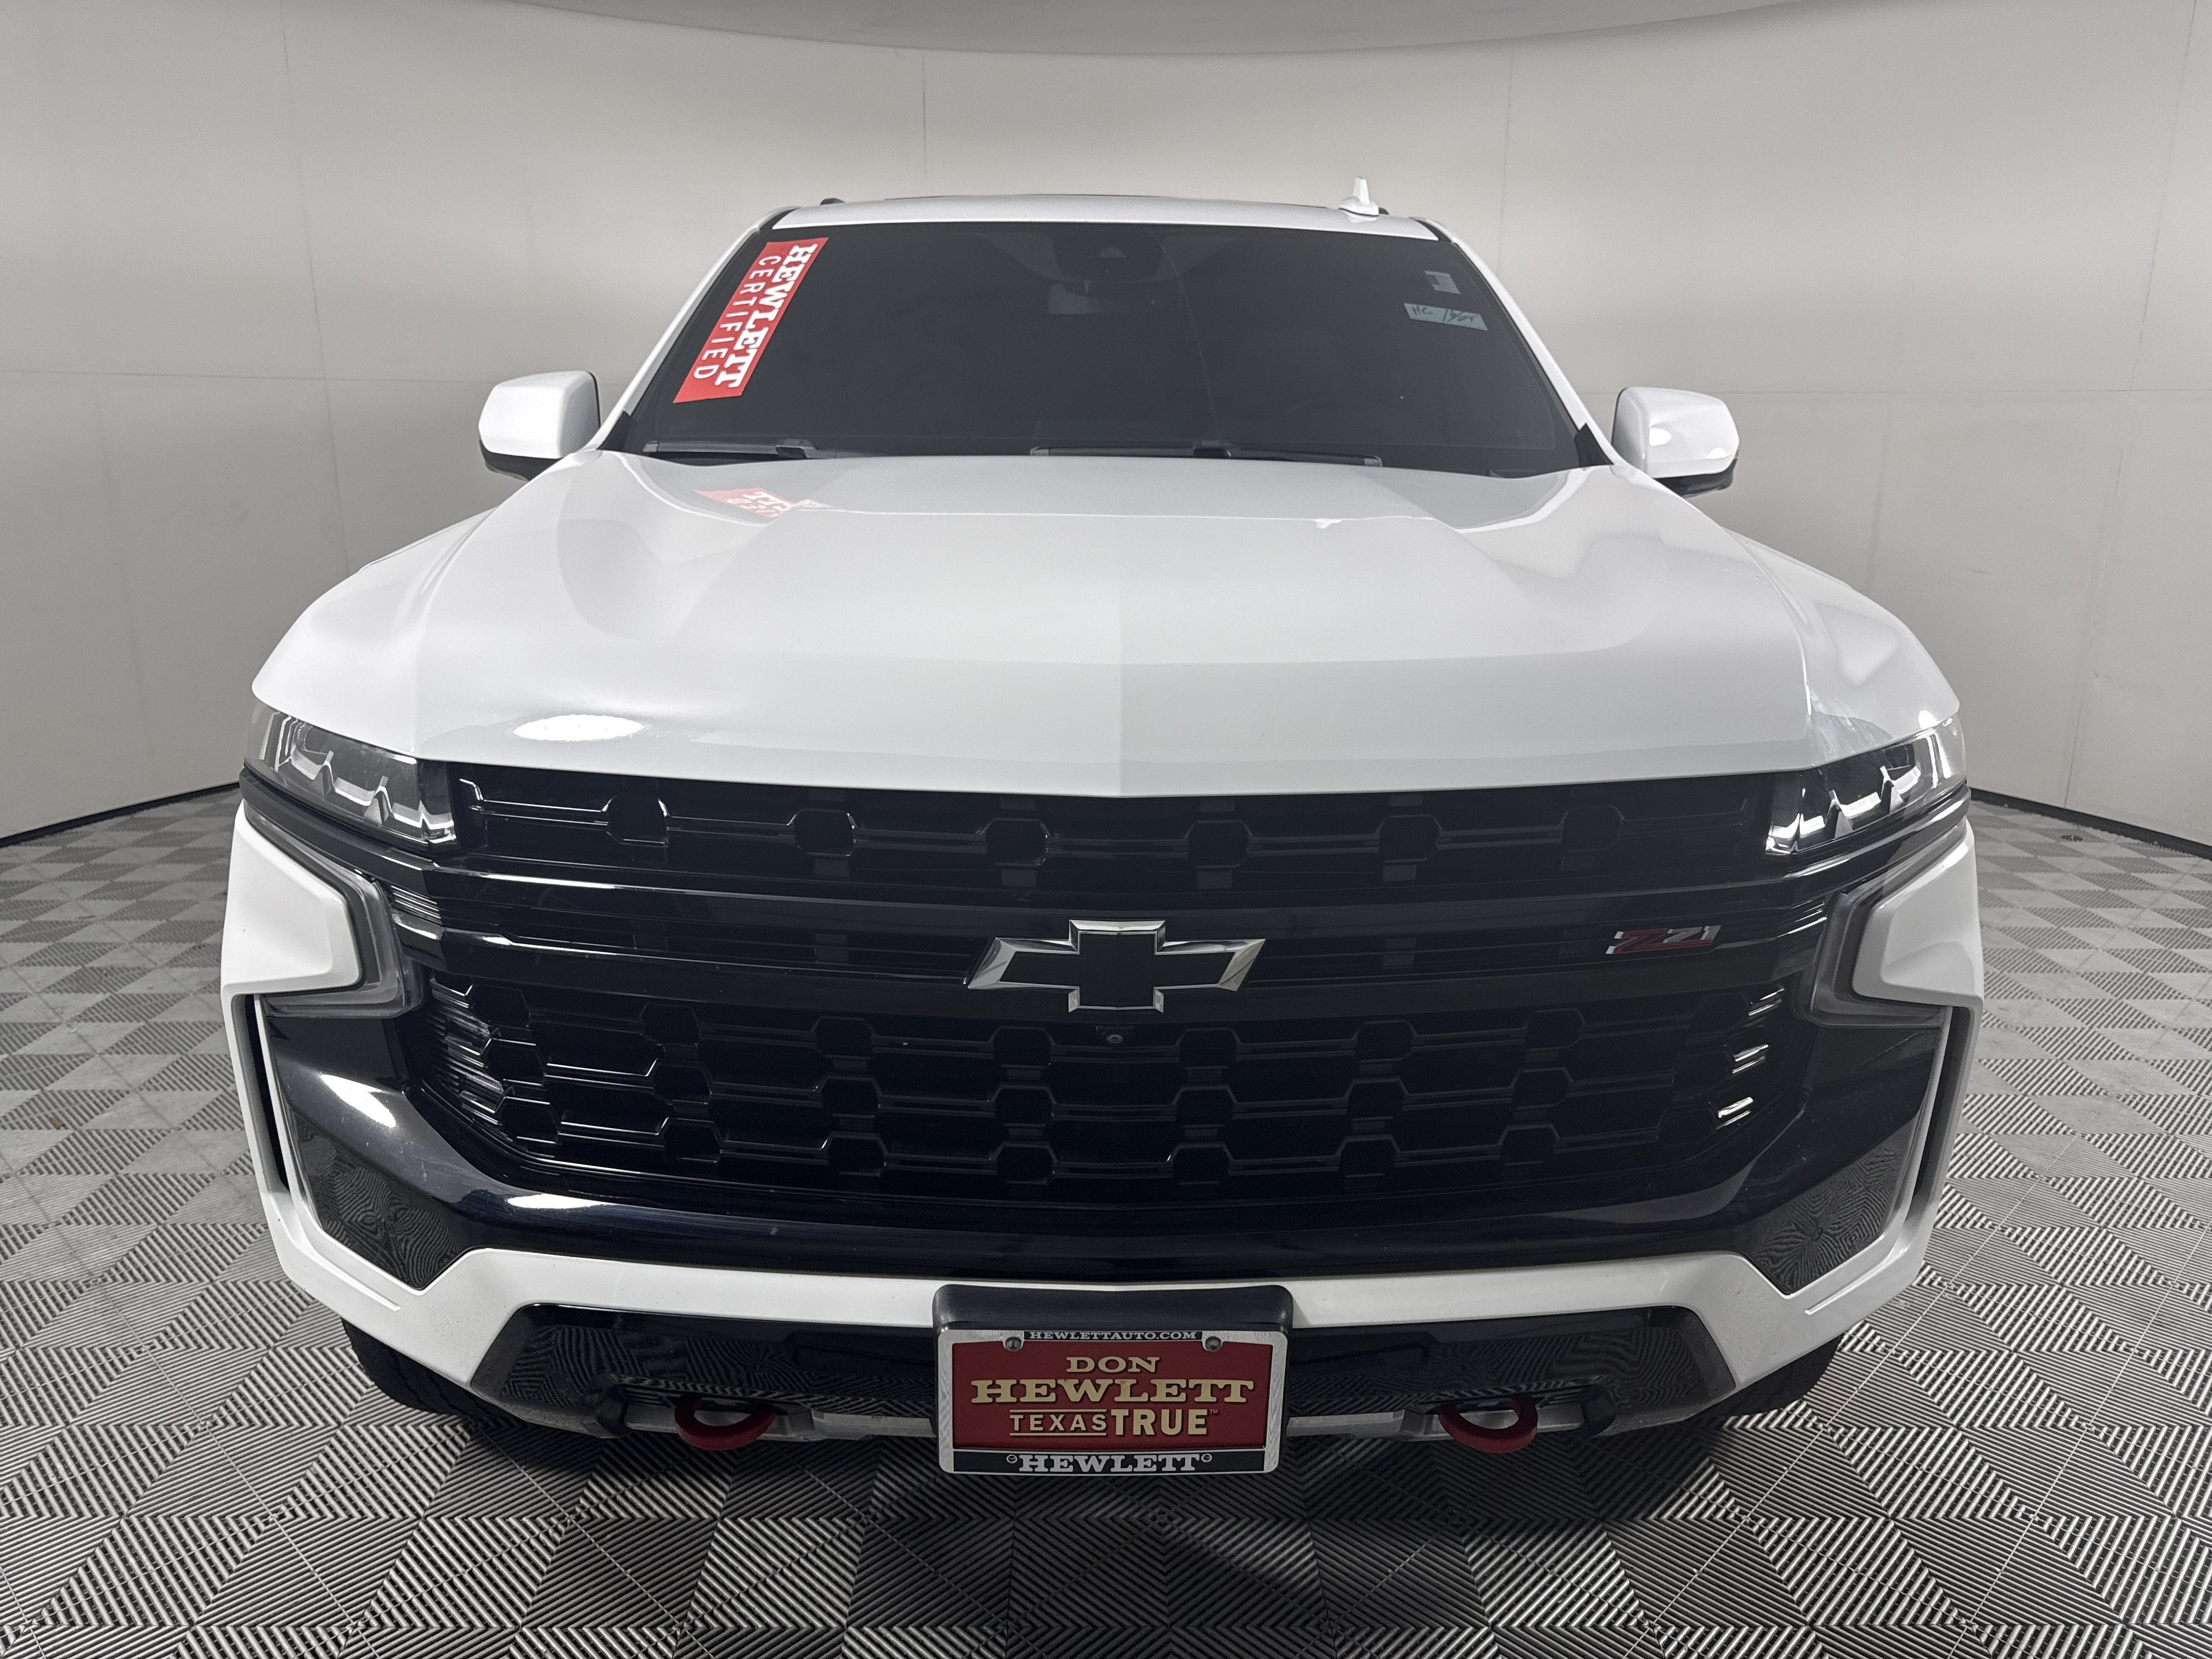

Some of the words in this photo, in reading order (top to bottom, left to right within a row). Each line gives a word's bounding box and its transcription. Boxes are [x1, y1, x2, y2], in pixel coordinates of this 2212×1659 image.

[693, 256, 781, 379] CERTIFIED
[714, 243, 818, 388] HEWLETT
[1605, 925, 1722, 954] Z71
[1029, 1331, 1197, 1340] HEWLETTAUTO.COM
[1066, 1356, 1160, 1373] DON
[971, 1379, 1254, 1403] HEWLETT
[1009, 1414, 1107, 1431] TEXAS
[1019, 1454, 1200, 1472] HEWLETT
